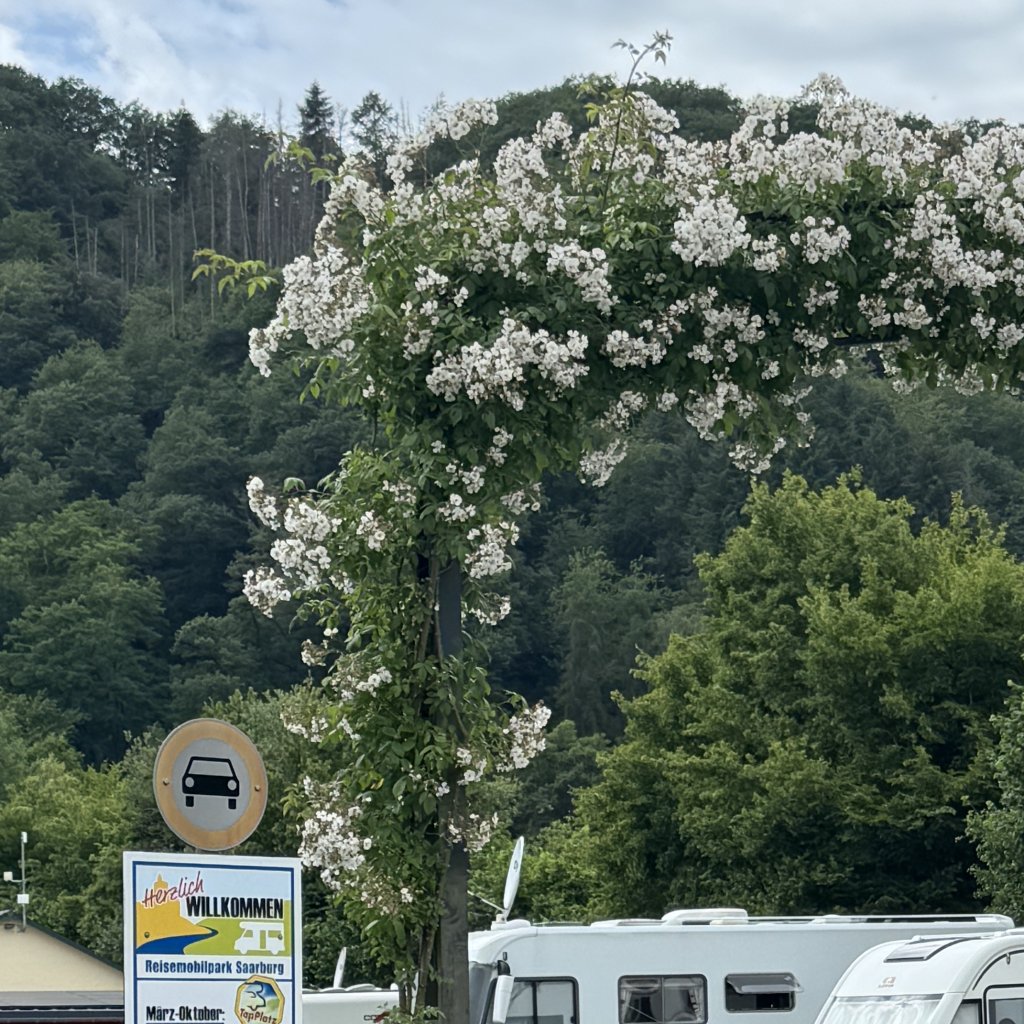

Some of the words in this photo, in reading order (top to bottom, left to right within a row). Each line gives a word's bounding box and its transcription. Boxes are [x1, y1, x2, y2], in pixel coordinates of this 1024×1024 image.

[142, 871, 204, 907] Herzlich
[186, 896, 284, 919] WILLKOMMEN
[145, 960, 232, 974] Reisemobilpark
[236, 961, 285, 975] Saarburg
[145, 1006, 226, 1021] März-Oktober:
